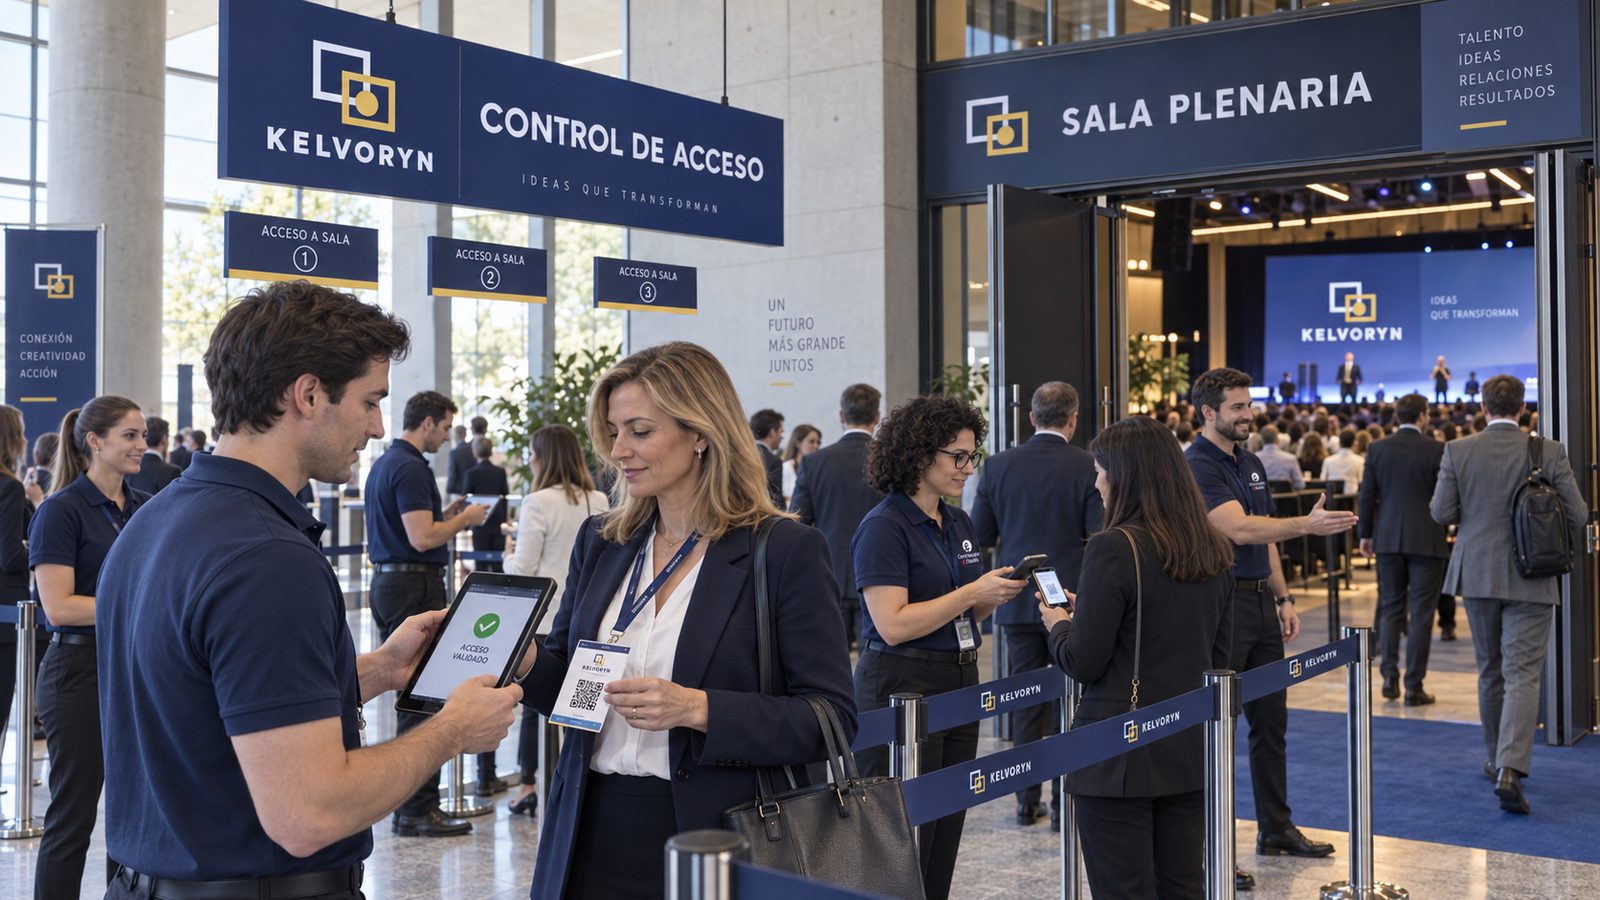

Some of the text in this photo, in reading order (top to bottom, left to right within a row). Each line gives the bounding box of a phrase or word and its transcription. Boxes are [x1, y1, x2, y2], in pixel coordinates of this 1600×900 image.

[1458, 25, 1524, 45] TALENTO
[1459, 49, 1501, 66] IDEAS
[1459, 63, 1553, 87] RELACIONES
[1062, 71, 1373, 136] SALA PLENARIA
[1459, 84, 1555, 107] RESULTADOS
[266, 125, 434, 173] KELVORYN
[480, 102, 764, 182] CONTROL DE ACCESO
[522, 173, 719, 214] IDEAS QUE TRANSFORMAN
[261, 225, 350, 246] ACCESO A SALA
[455, 249, 525, 266] ACCESO A SALA
[619, 266, 678, 281] ACCESO A SALA
[768, 298, 785, 312] UN
[1430, 295, 1458, 306] IDEAS
[1430, 308, 1519, 321] QUE TRANSFORMAN
[768, 316, 815, 332] FUTURO
[20, 332, 73, 344] CONEXIÓN
[1301, 326, 1403, 342] KELVORYN
[768, 335, 846, 352] MÁS GRANDE
[20, 351, 86, 361] CREATIVIDAD
[19, 366, 57, 378] ACCIÓN
[768, 358, 814, 373] JUNTOS
[460, 643, 490, 654] ACCESO
[452, 652, 489, 664] VALIDADO
[1000, 684, 1041, 703] KELVORYN
[1141, 711, 1180, 733] KELVORYN
[989, 760, 1032, 784] KELVORYN
